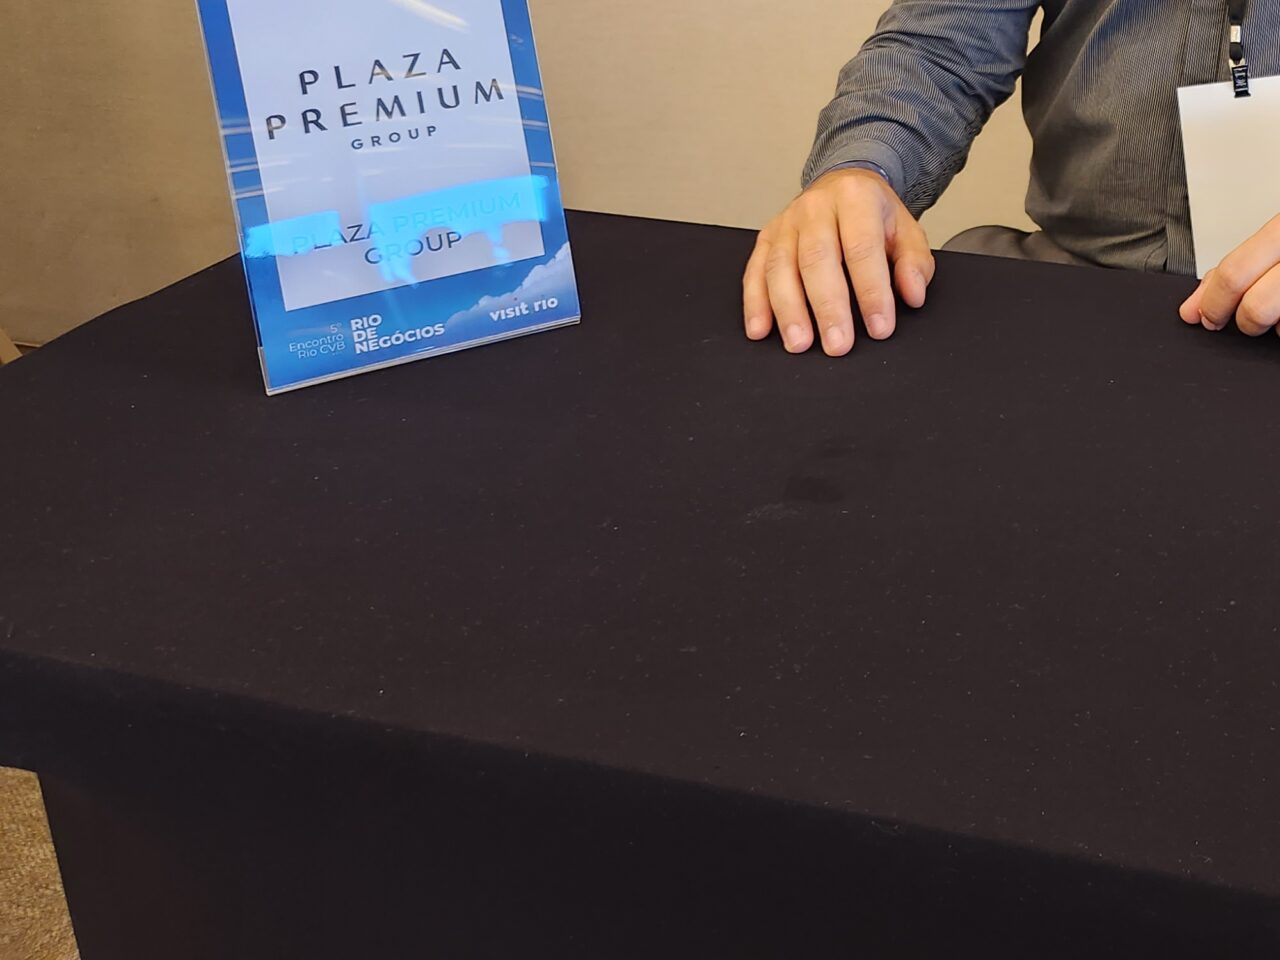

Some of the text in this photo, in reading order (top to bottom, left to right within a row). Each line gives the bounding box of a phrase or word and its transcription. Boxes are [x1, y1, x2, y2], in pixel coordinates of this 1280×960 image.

[299, 48, 461, 95] PLAZA
[265, 78, 504, 140] PREMIUM
[351, 125, 437, 150] GROUP
[292, 191, 521, 254] PLAZA PREMIUM
[364, 231, 462, 265] GROUP
[350, 314, 382, 331] RIO
[352, 329, 378, 342] DE
[289, 334, 344, 352] Encontro
[298, 341, 346, 359] Rio CVB
[354, 323, 445, 354] NEGÓCIOS
